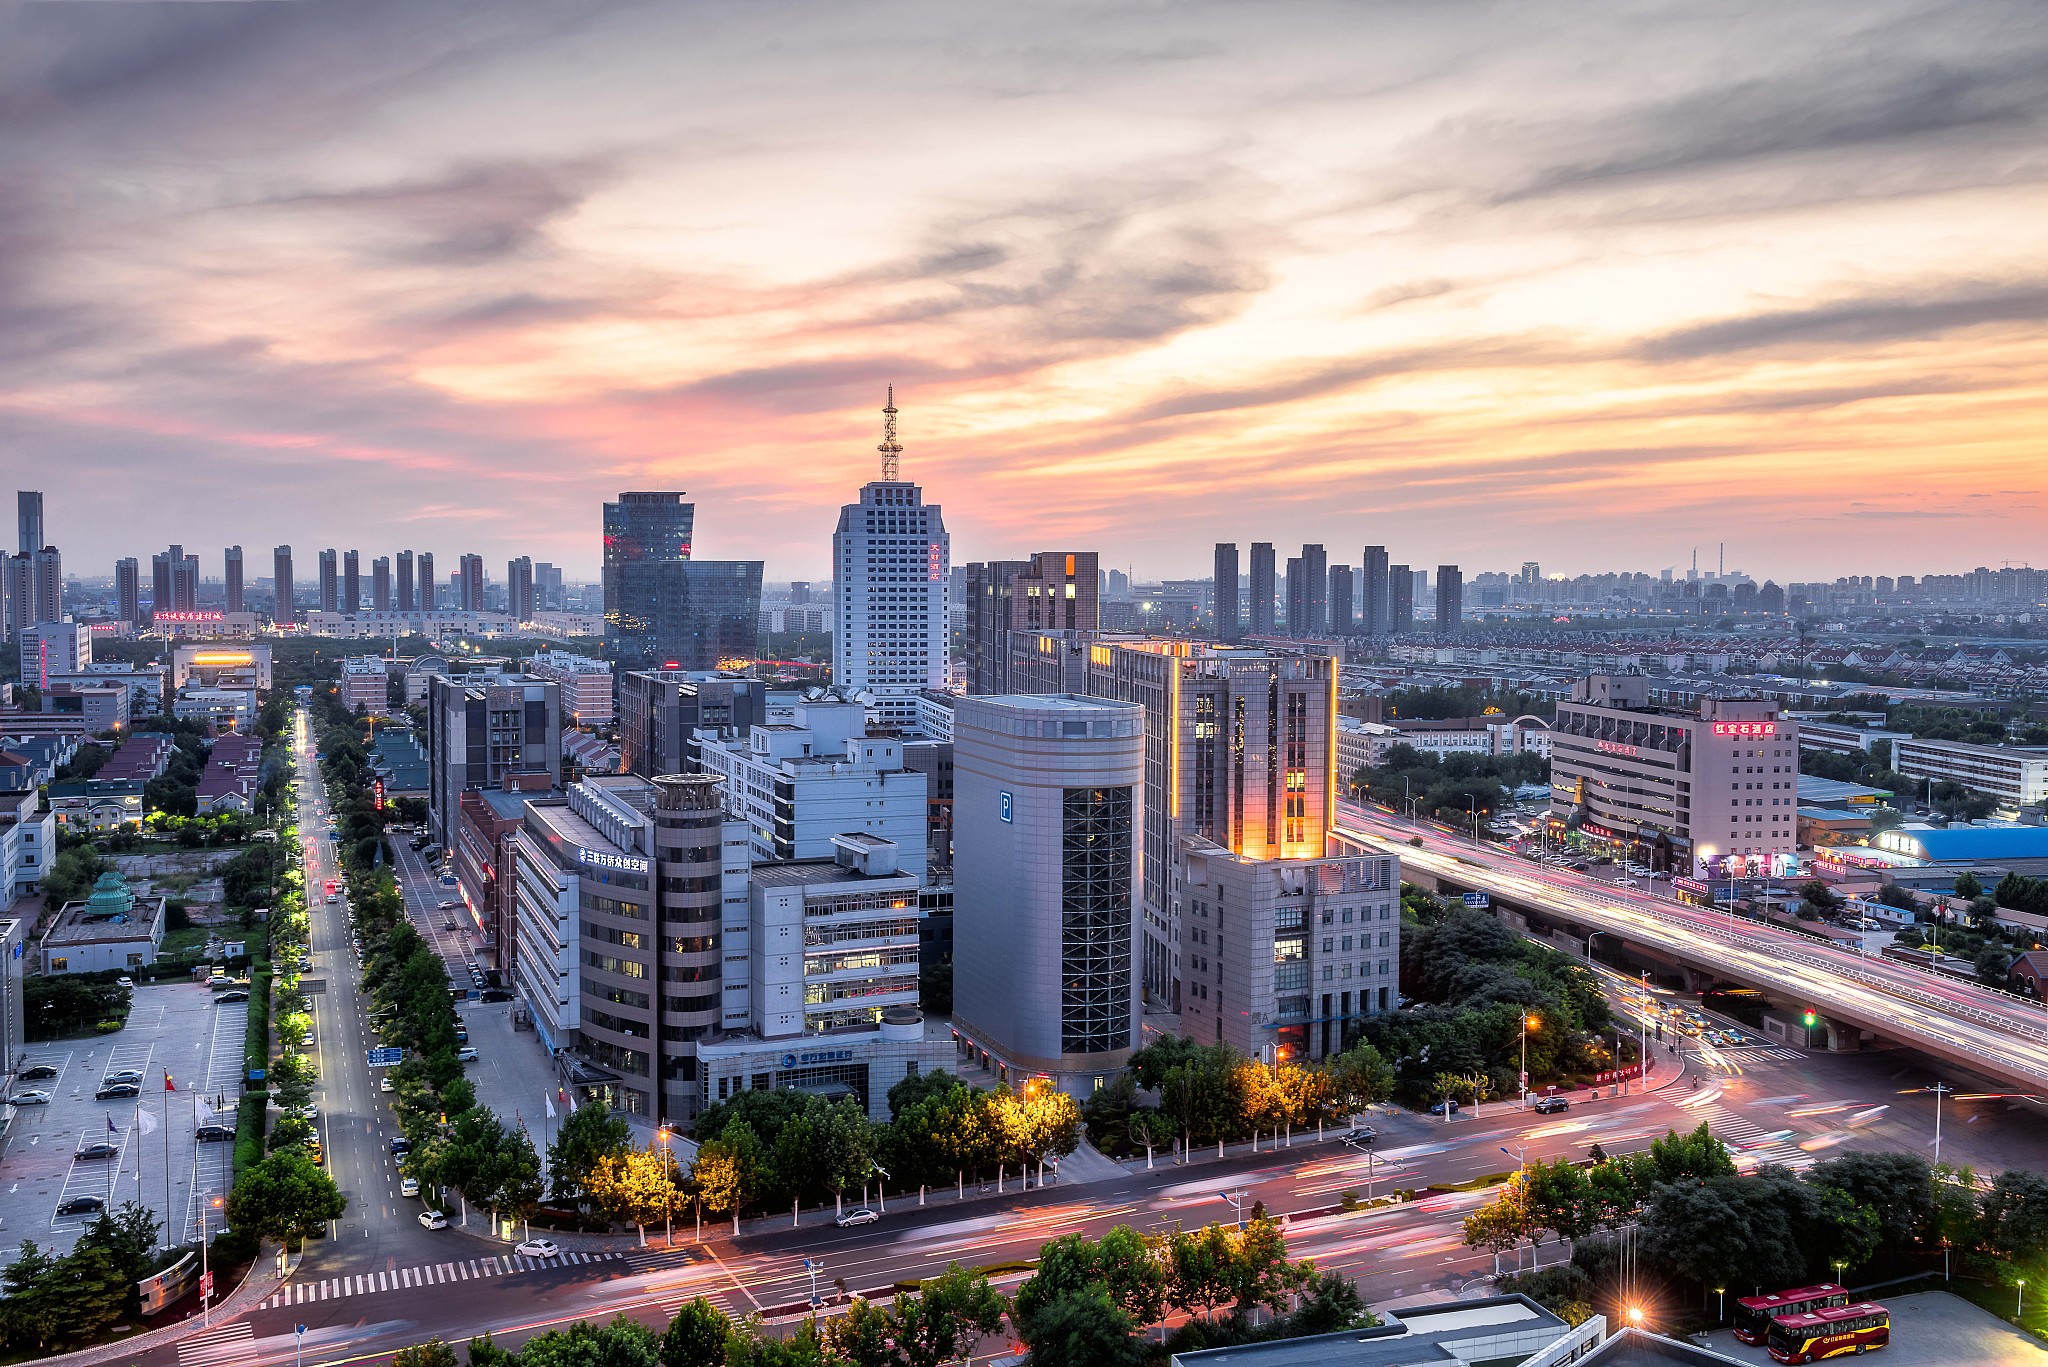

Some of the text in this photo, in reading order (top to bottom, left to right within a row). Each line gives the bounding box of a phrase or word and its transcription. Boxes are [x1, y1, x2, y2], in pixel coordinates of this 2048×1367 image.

[1715, 723, 1775, 734] 红宝石酒店
